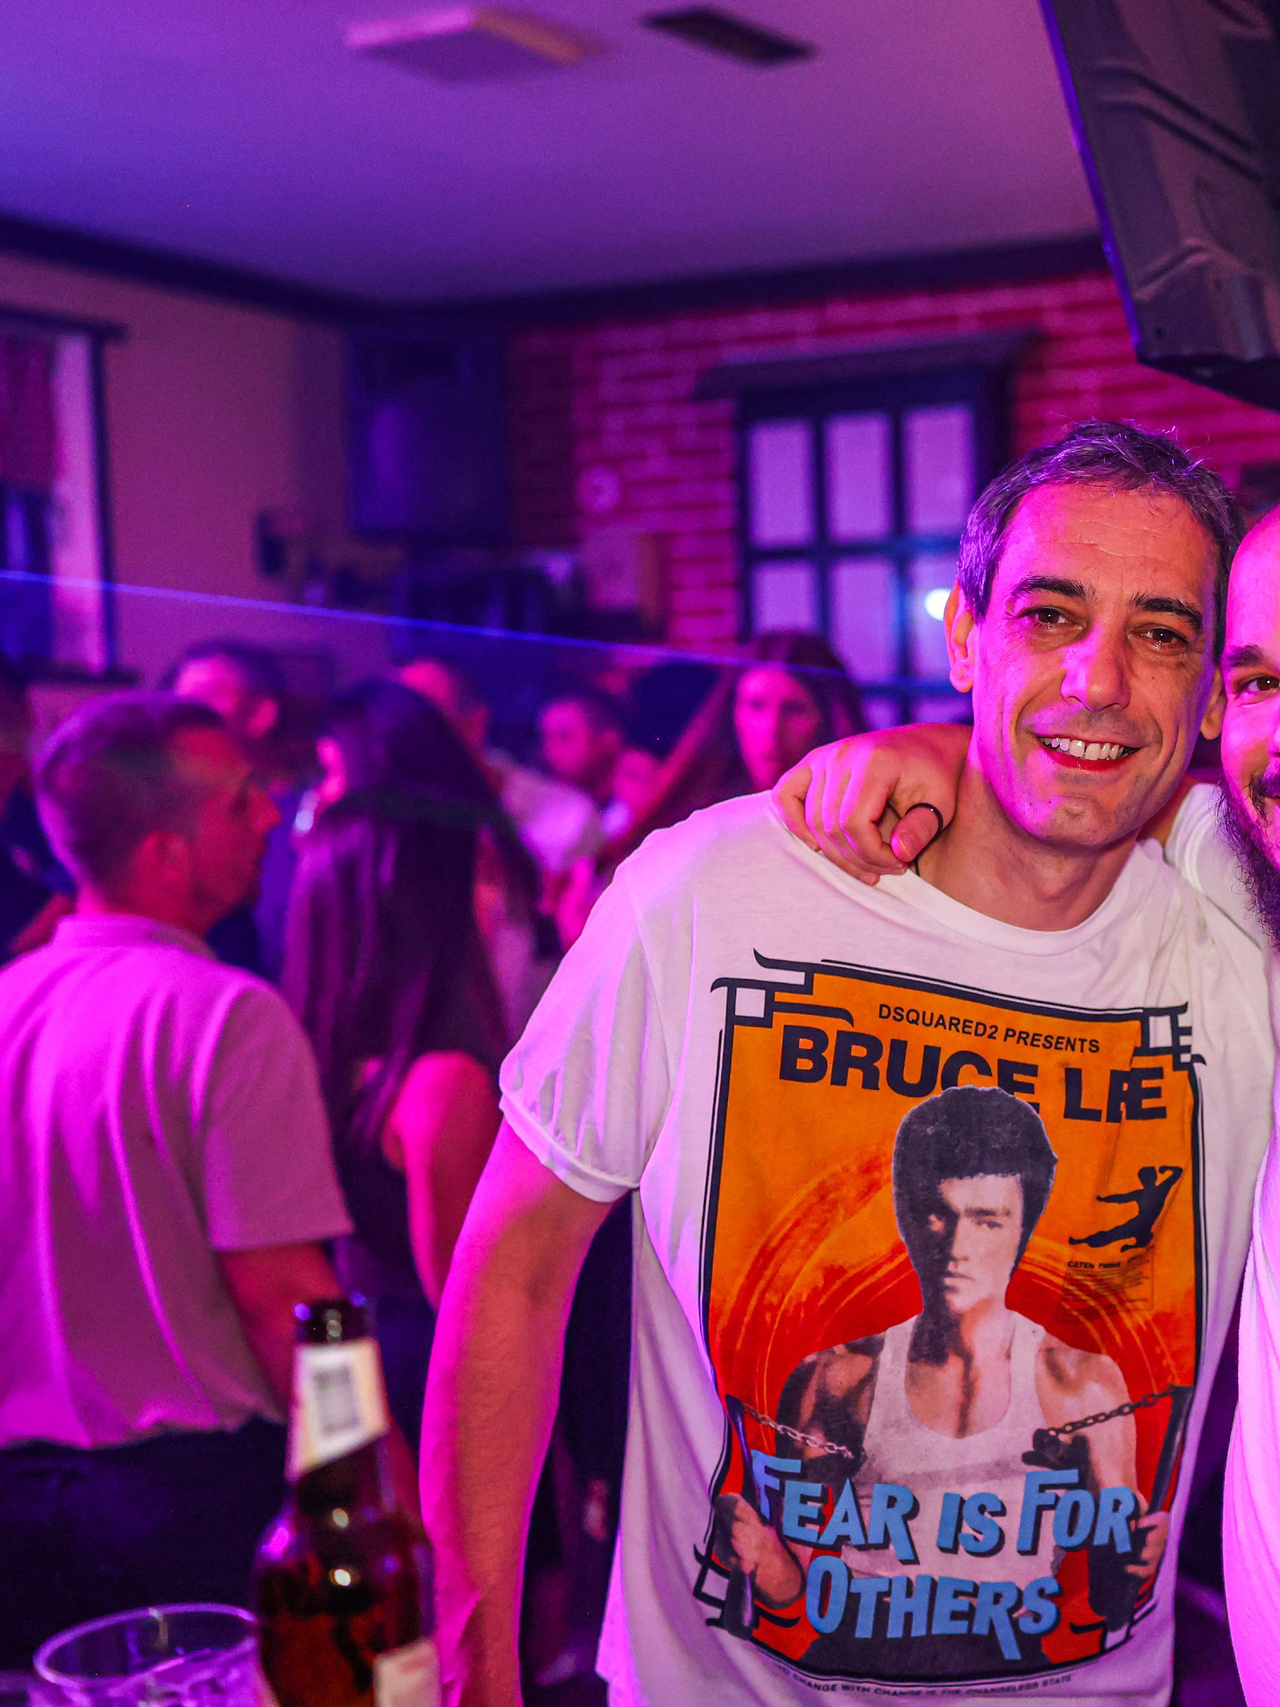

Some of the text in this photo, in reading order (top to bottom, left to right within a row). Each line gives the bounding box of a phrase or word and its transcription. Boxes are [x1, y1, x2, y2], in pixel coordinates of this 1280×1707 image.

[878, 1003, 1101, 1054] DSQUARED2 PRESENTS
[751, 1449, 1137, 1564] FEAR IS FOR
[804, 1555, 1062, 1661] OTHERS
[841, 1684, 871, 1694] WITH
